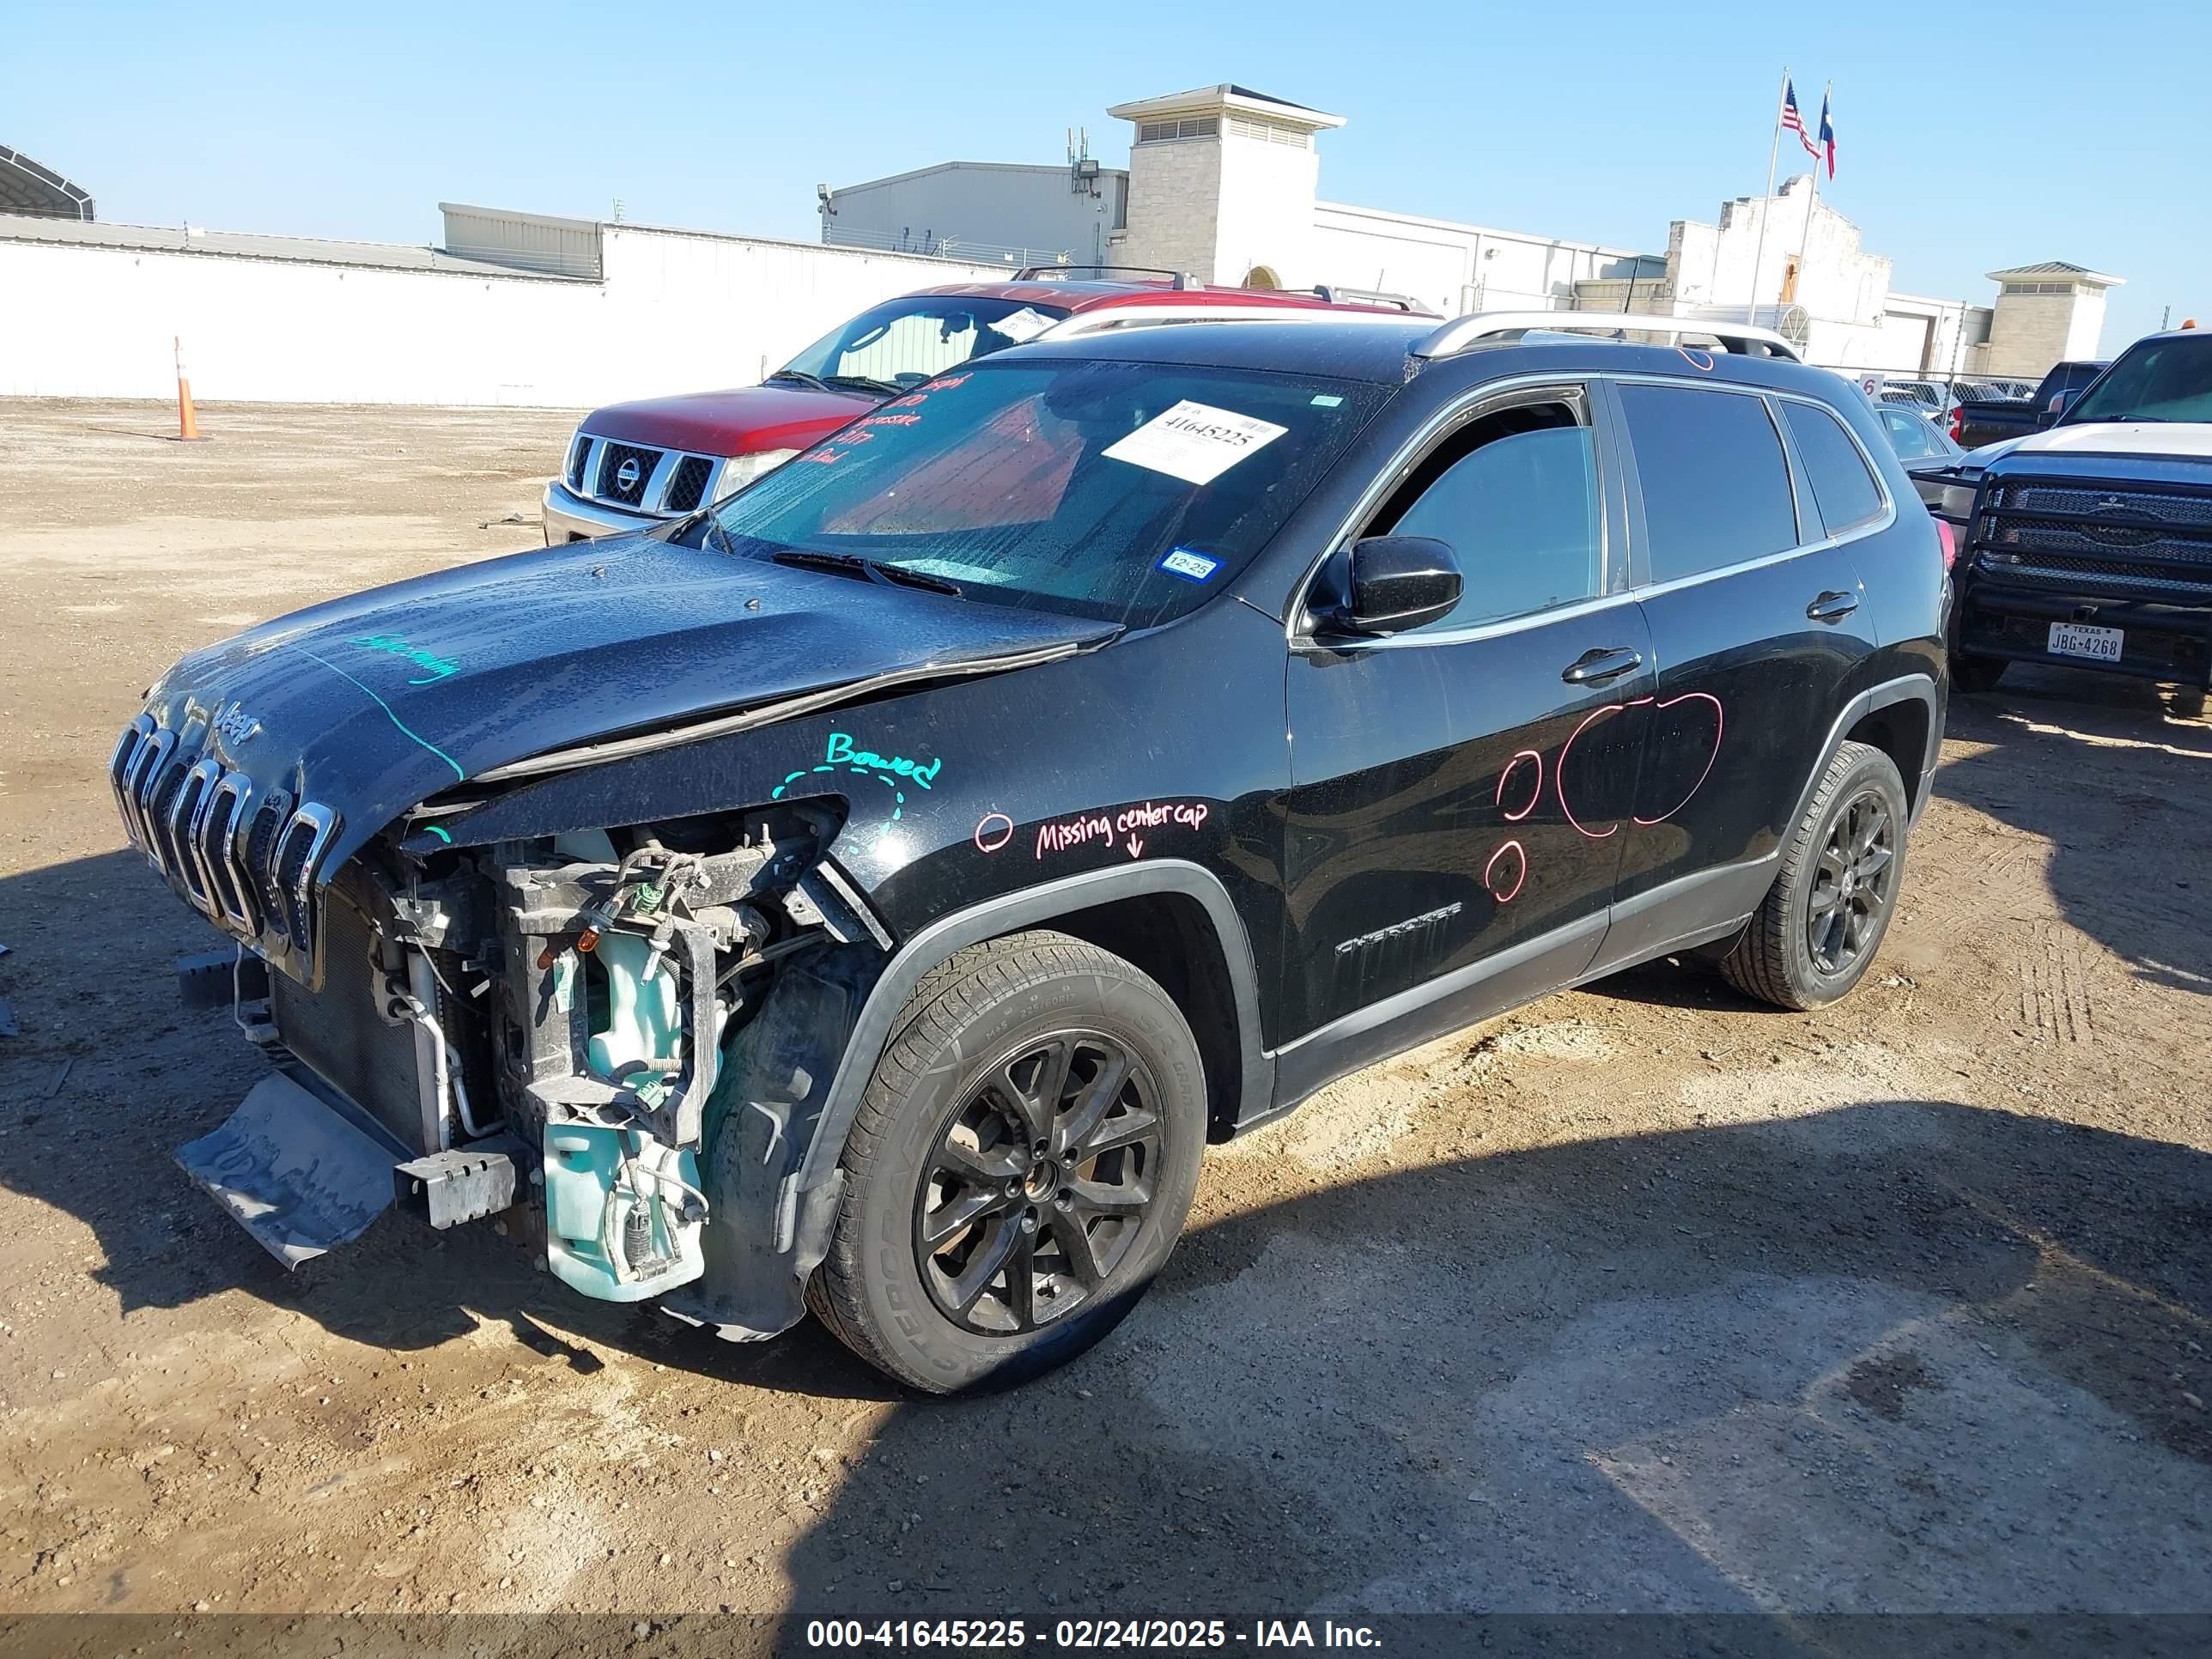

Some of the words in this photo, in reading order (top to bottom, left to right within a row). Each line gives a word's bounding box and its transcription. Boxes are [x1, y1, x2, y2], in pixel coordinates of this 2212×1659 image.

[1863, 379, 1876, 396] 6
[1164, 416, 1255, 447] 41645225
[2074, 625, 2102, 635] TEXAS
[1036, 816, 1115, 860] Missing
[1115, 801, 1174, 834] center
[1173, 803, 1208, 831] cap
